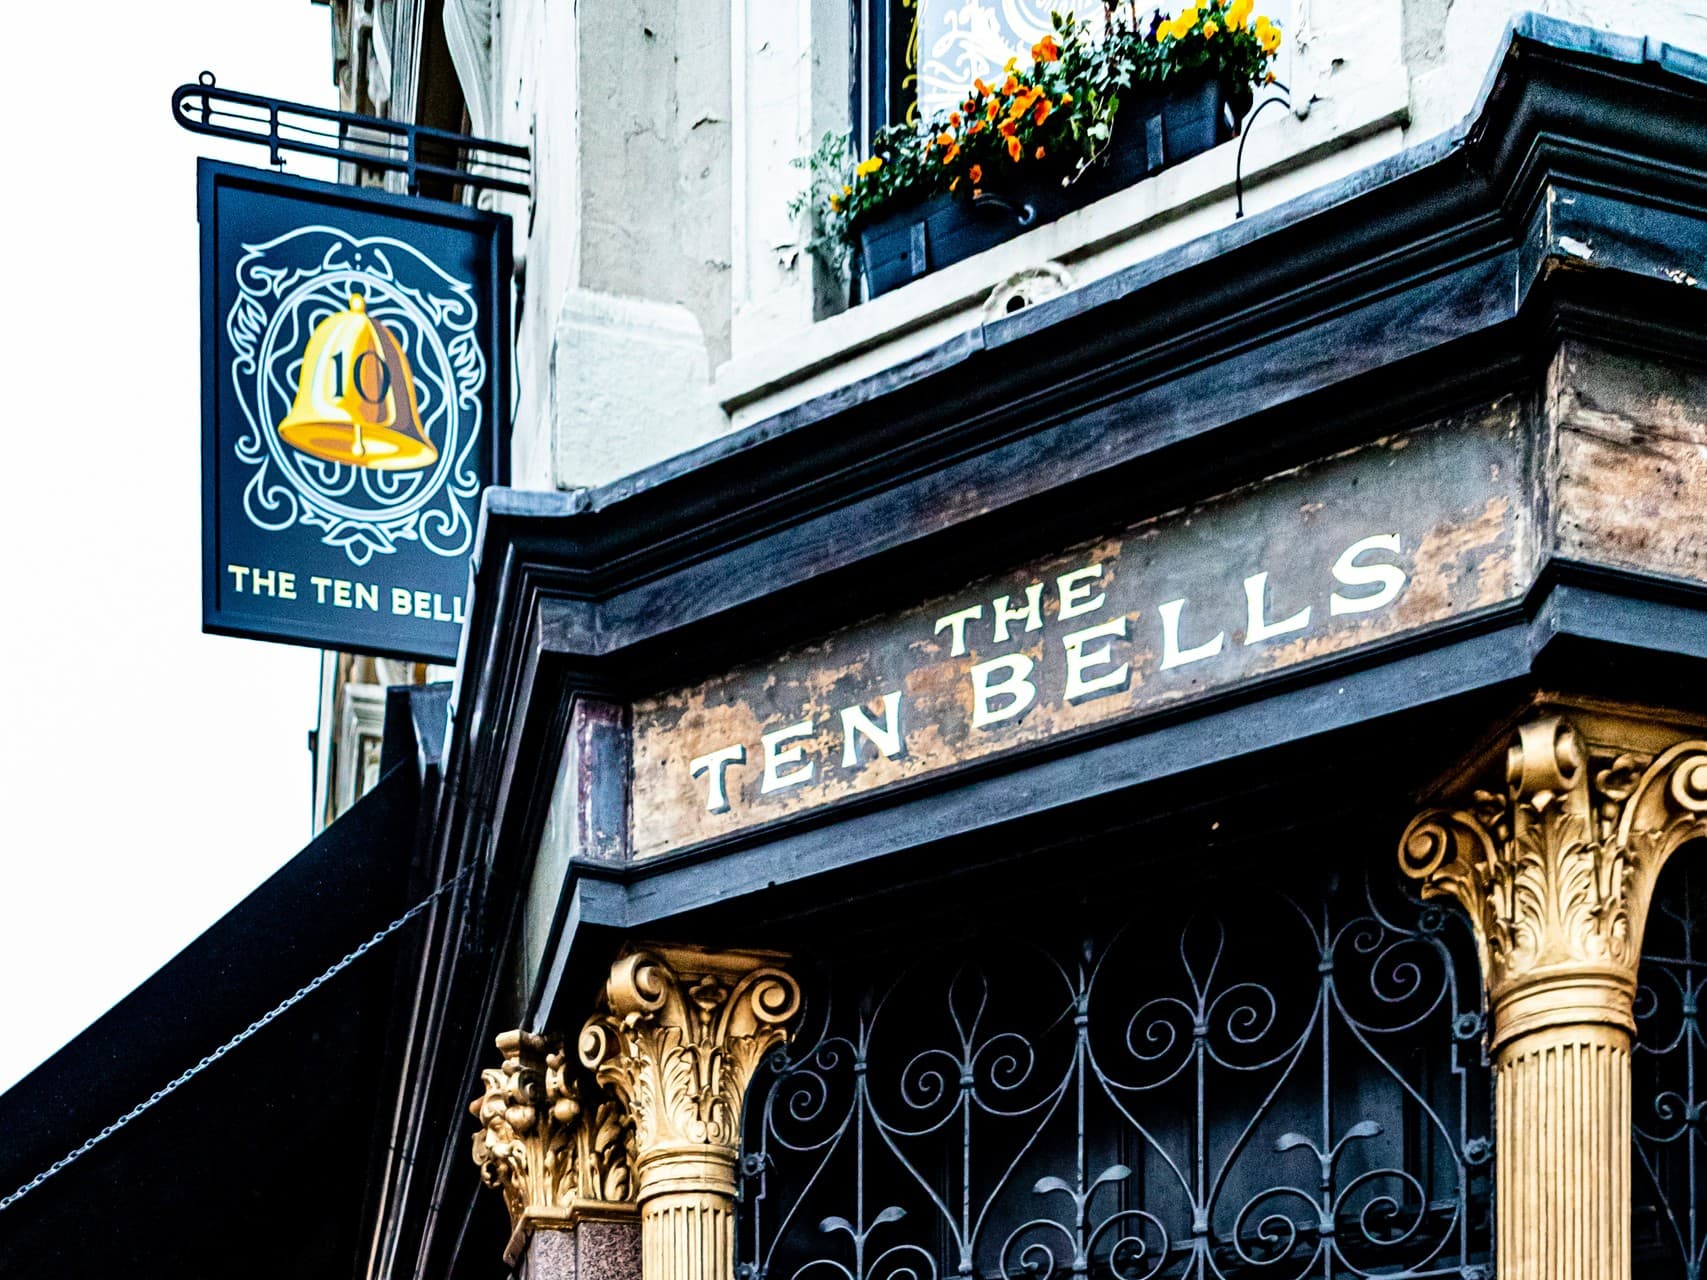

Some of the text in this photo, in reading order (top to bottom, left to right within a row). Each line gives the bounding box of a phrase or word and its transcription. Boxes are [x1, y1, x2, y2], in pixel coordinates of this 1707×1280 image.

[331, 350, 391, 405] 10
[228, 565, 465, 624] THE TEN BELL
[934, 563, 1107, 658] THE
[690, 533, 1408, 815] TEN BELLS
